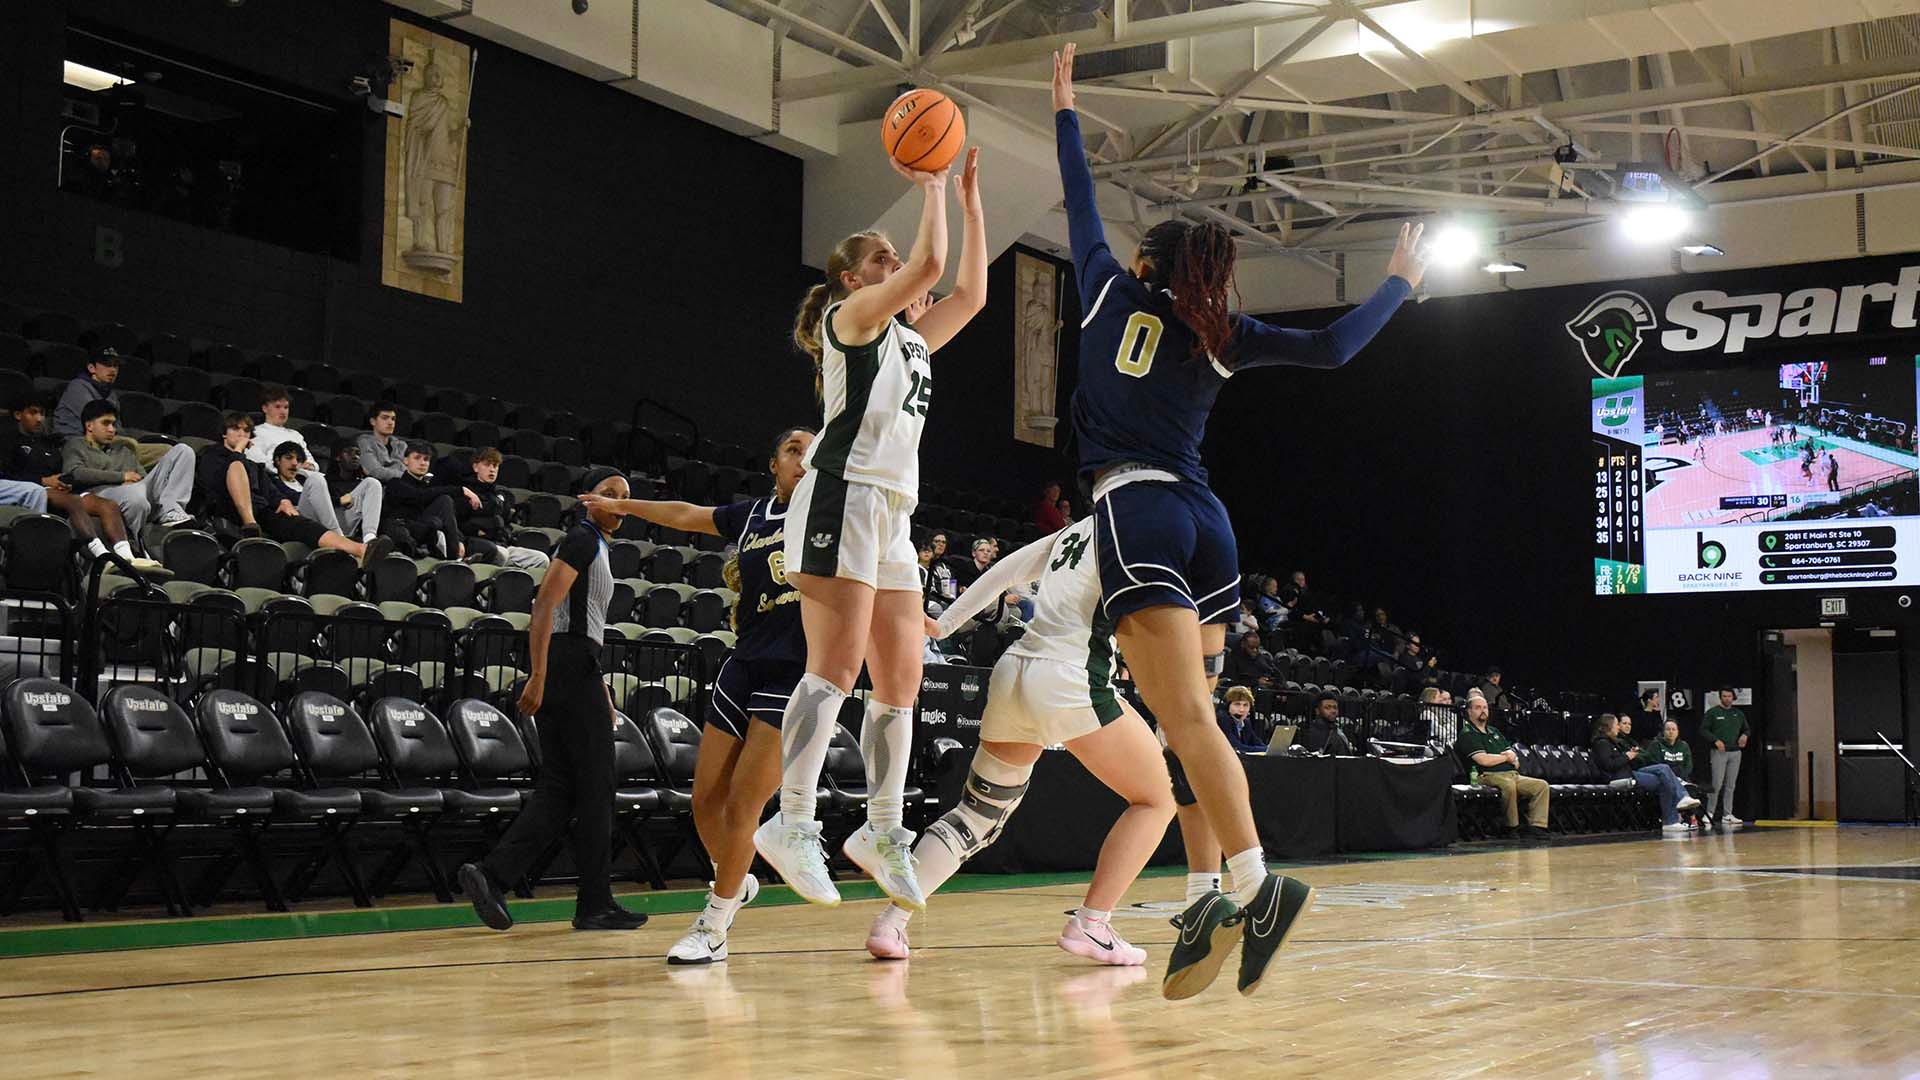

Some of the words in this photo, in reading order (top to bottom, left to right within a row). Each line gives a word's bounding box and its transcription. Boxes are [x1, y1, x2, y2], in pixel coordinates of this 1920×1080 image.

[1115, 311, 1164, 378] 0
[902, 370, 931, 417] 25
[1611, 456, 1625, 466] PTS
[1632, 456, 1637, 465] F
[1596, 472, 1607, 483] 13
[1616, 471, 1622, 482] 2
[1631, 470, 1638, 482] 0
[1596, 487, 1608, 498] 25
[1616, 486, 1622, 497] 5
[1631, 485, 1638, 497] 0
[1599, 502, 1605, 513] 3
[1616, 501, 1622, 512] 0
[1632, 500, 1638, 512] 0
[1757, 497, 1769, 506] 30
[1596, 517, 1608, 528] 34
[1616, 516, 1623, 527] 4
[1632, 515, 1639, 527] 0
[1597, 532, 1608, 543] 35
[1617, 531, 1623, 542] 5
[1633, 531, 1638, 542] 1
[1785, 542, 1835, 551] Spartanburg,
[1792, 557, 1840, 565] 864-706-0761
[1596, 576, 1612, 585] 3PT:
[1617, 575, 1622, 584] 2
[1714, 572, 1743, 580] NINE
[1787, 571, 1893, 580] spartanburg@thebackninegolf.com
[1596, 585, 1612, 595] REB:
[1616, 584, 1625, 594] 14
[1825, 600, 1842, 612] EXIT
[929, 681, 949, 690] FOUNDERS
[24, 692, 71, 706] Upstate
[125, 698, 168, 711] Upstate
[1671, 692, 1686, 708] 8
[218, 701, 258, 714] Upstate
[308, 704, 345, 716] Upstate
[390, 708, 425, 721] Upstate
[466, 711, 499, 722] Upstate
[920, 708, 947, 725] ingles
